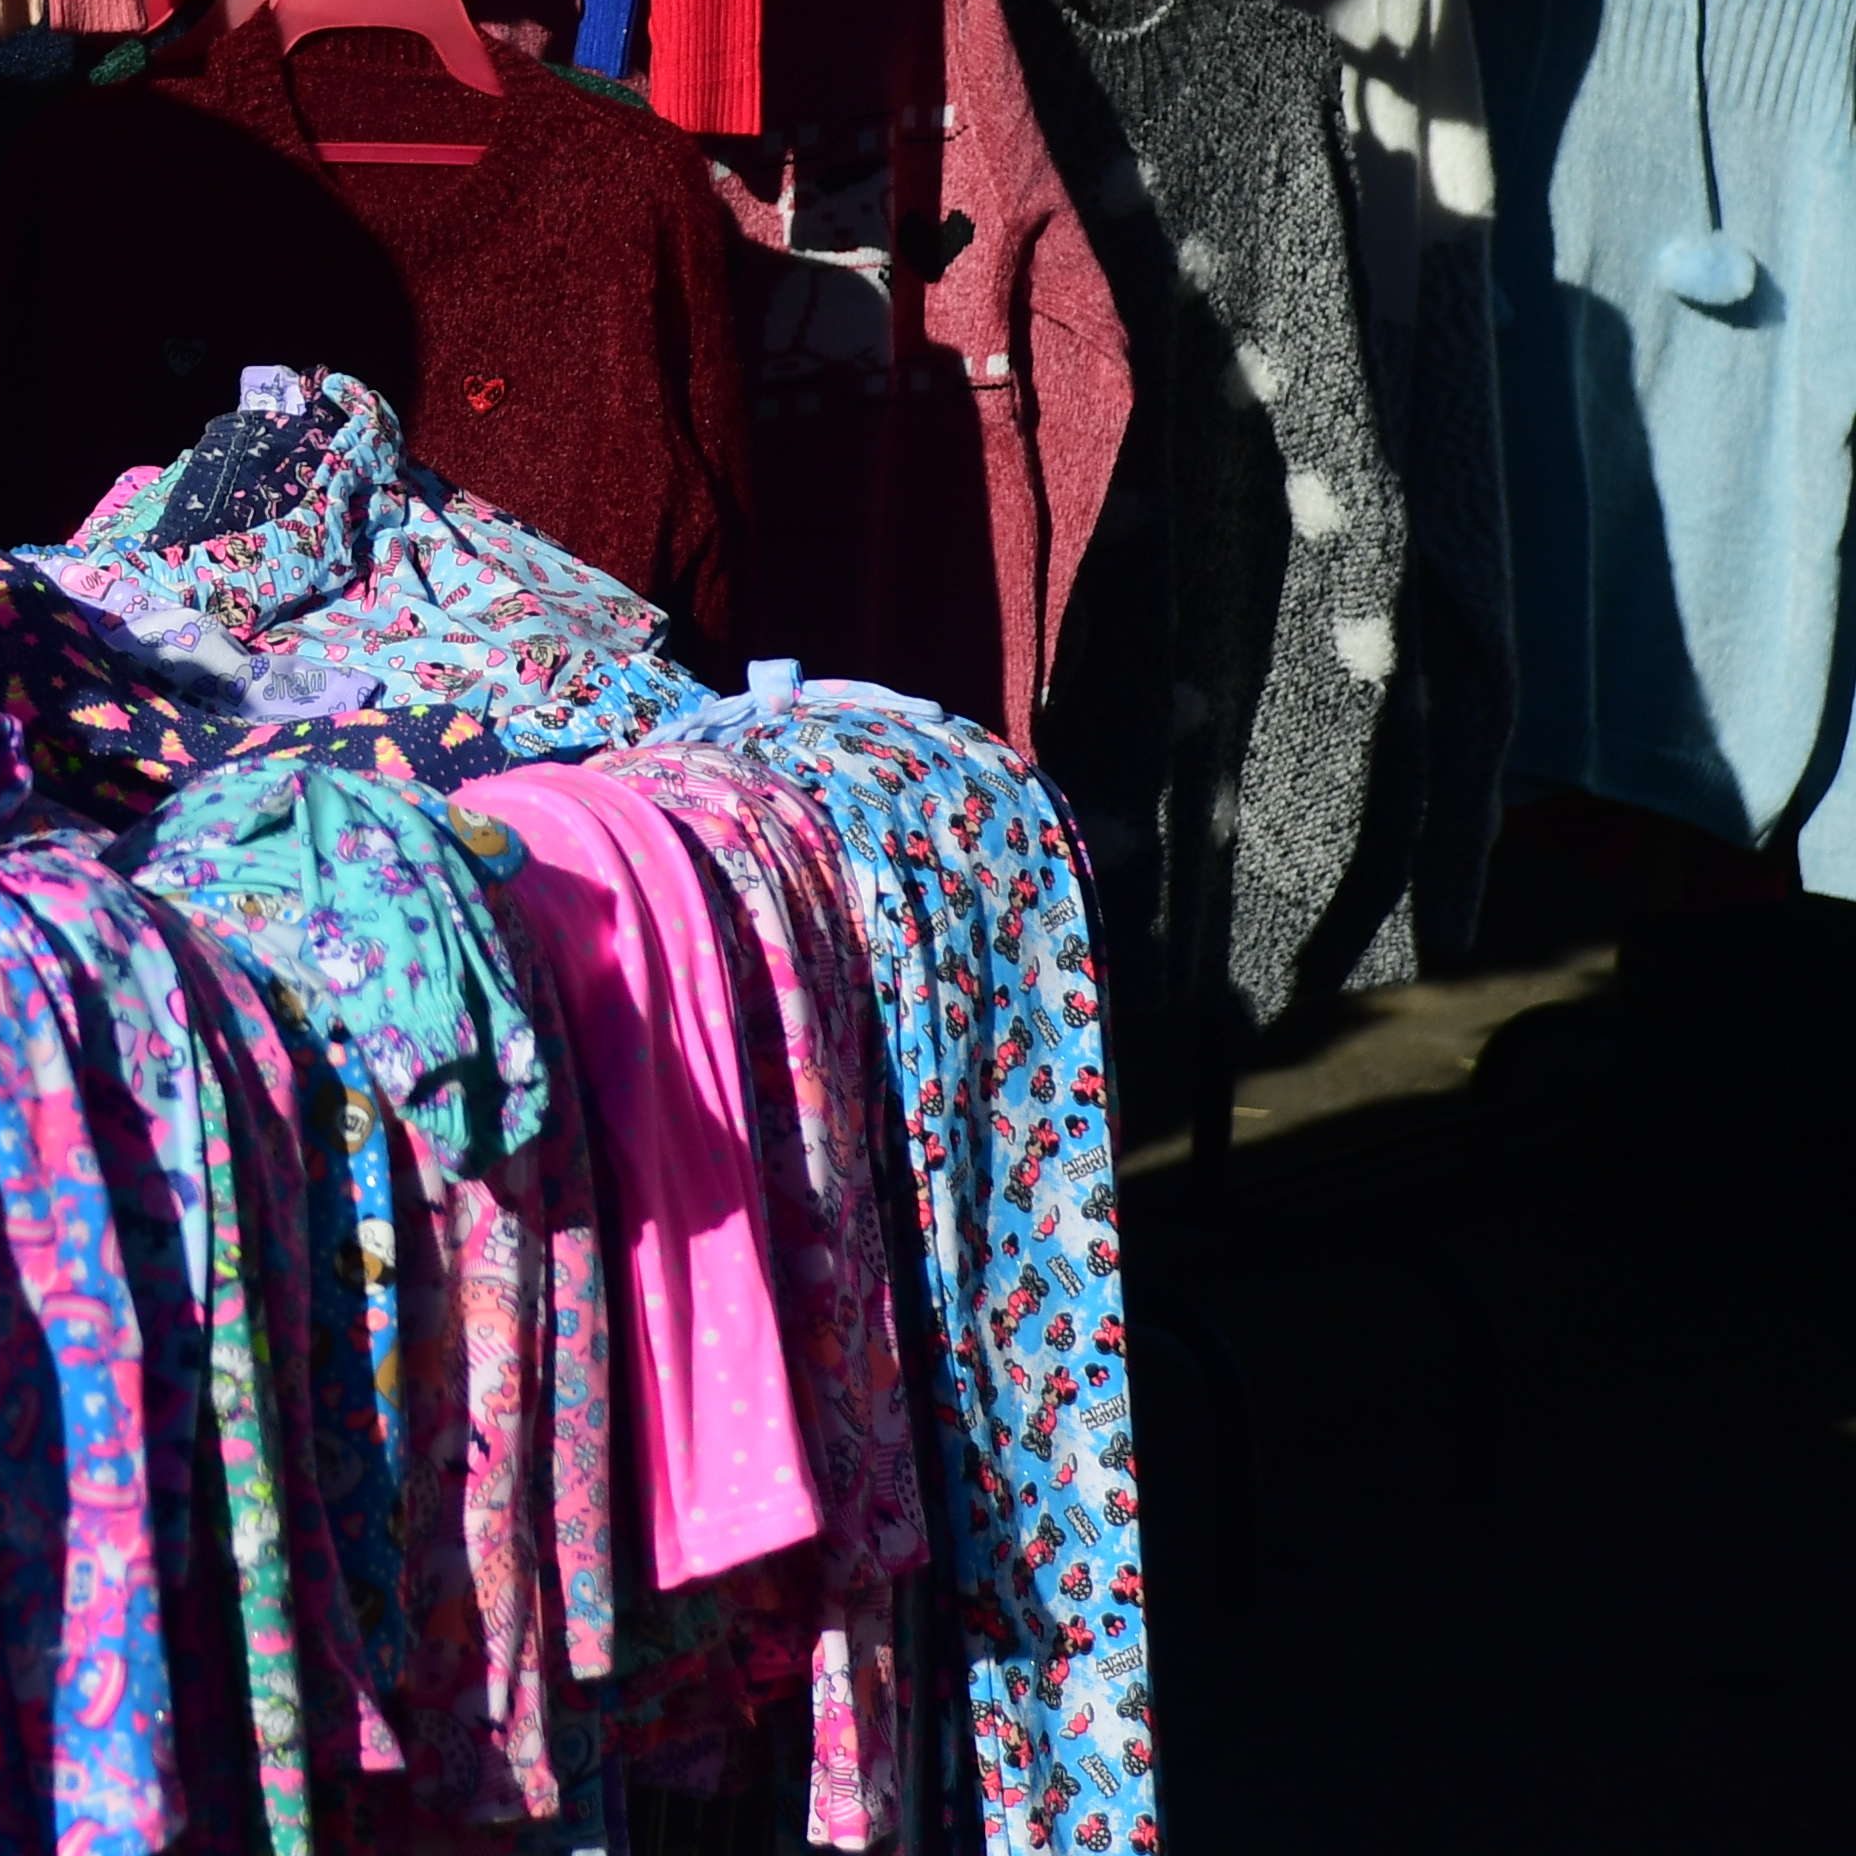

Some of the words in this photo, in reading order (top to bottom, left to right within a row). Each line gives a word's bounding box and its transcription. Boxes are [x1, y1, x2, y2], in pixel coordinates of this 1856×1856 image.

[80, 571, 105, 591] LOVE
[263, 669, 326, 700] dream
[1063, 1145, 1107, 1175] MINNIE
[1067, 1158, 1108, 1182] MOUSE
[1057, 1254, 1085, 1292] MOUSE
[1080, 1394, 1126, 1424] MINNIE
[1085, 1407, 1126, 1430] MOUSE
[1074, 1504, 1102, 1541] MOUSE
[1096, 1644, 1142, 1673] MINNIE
[1103, 1658, 1142, 1680] MOUSE
[1077, 1756, 1116, 1799] MINNIE
[1089, 1753, 1121, 1790] MOUSE
